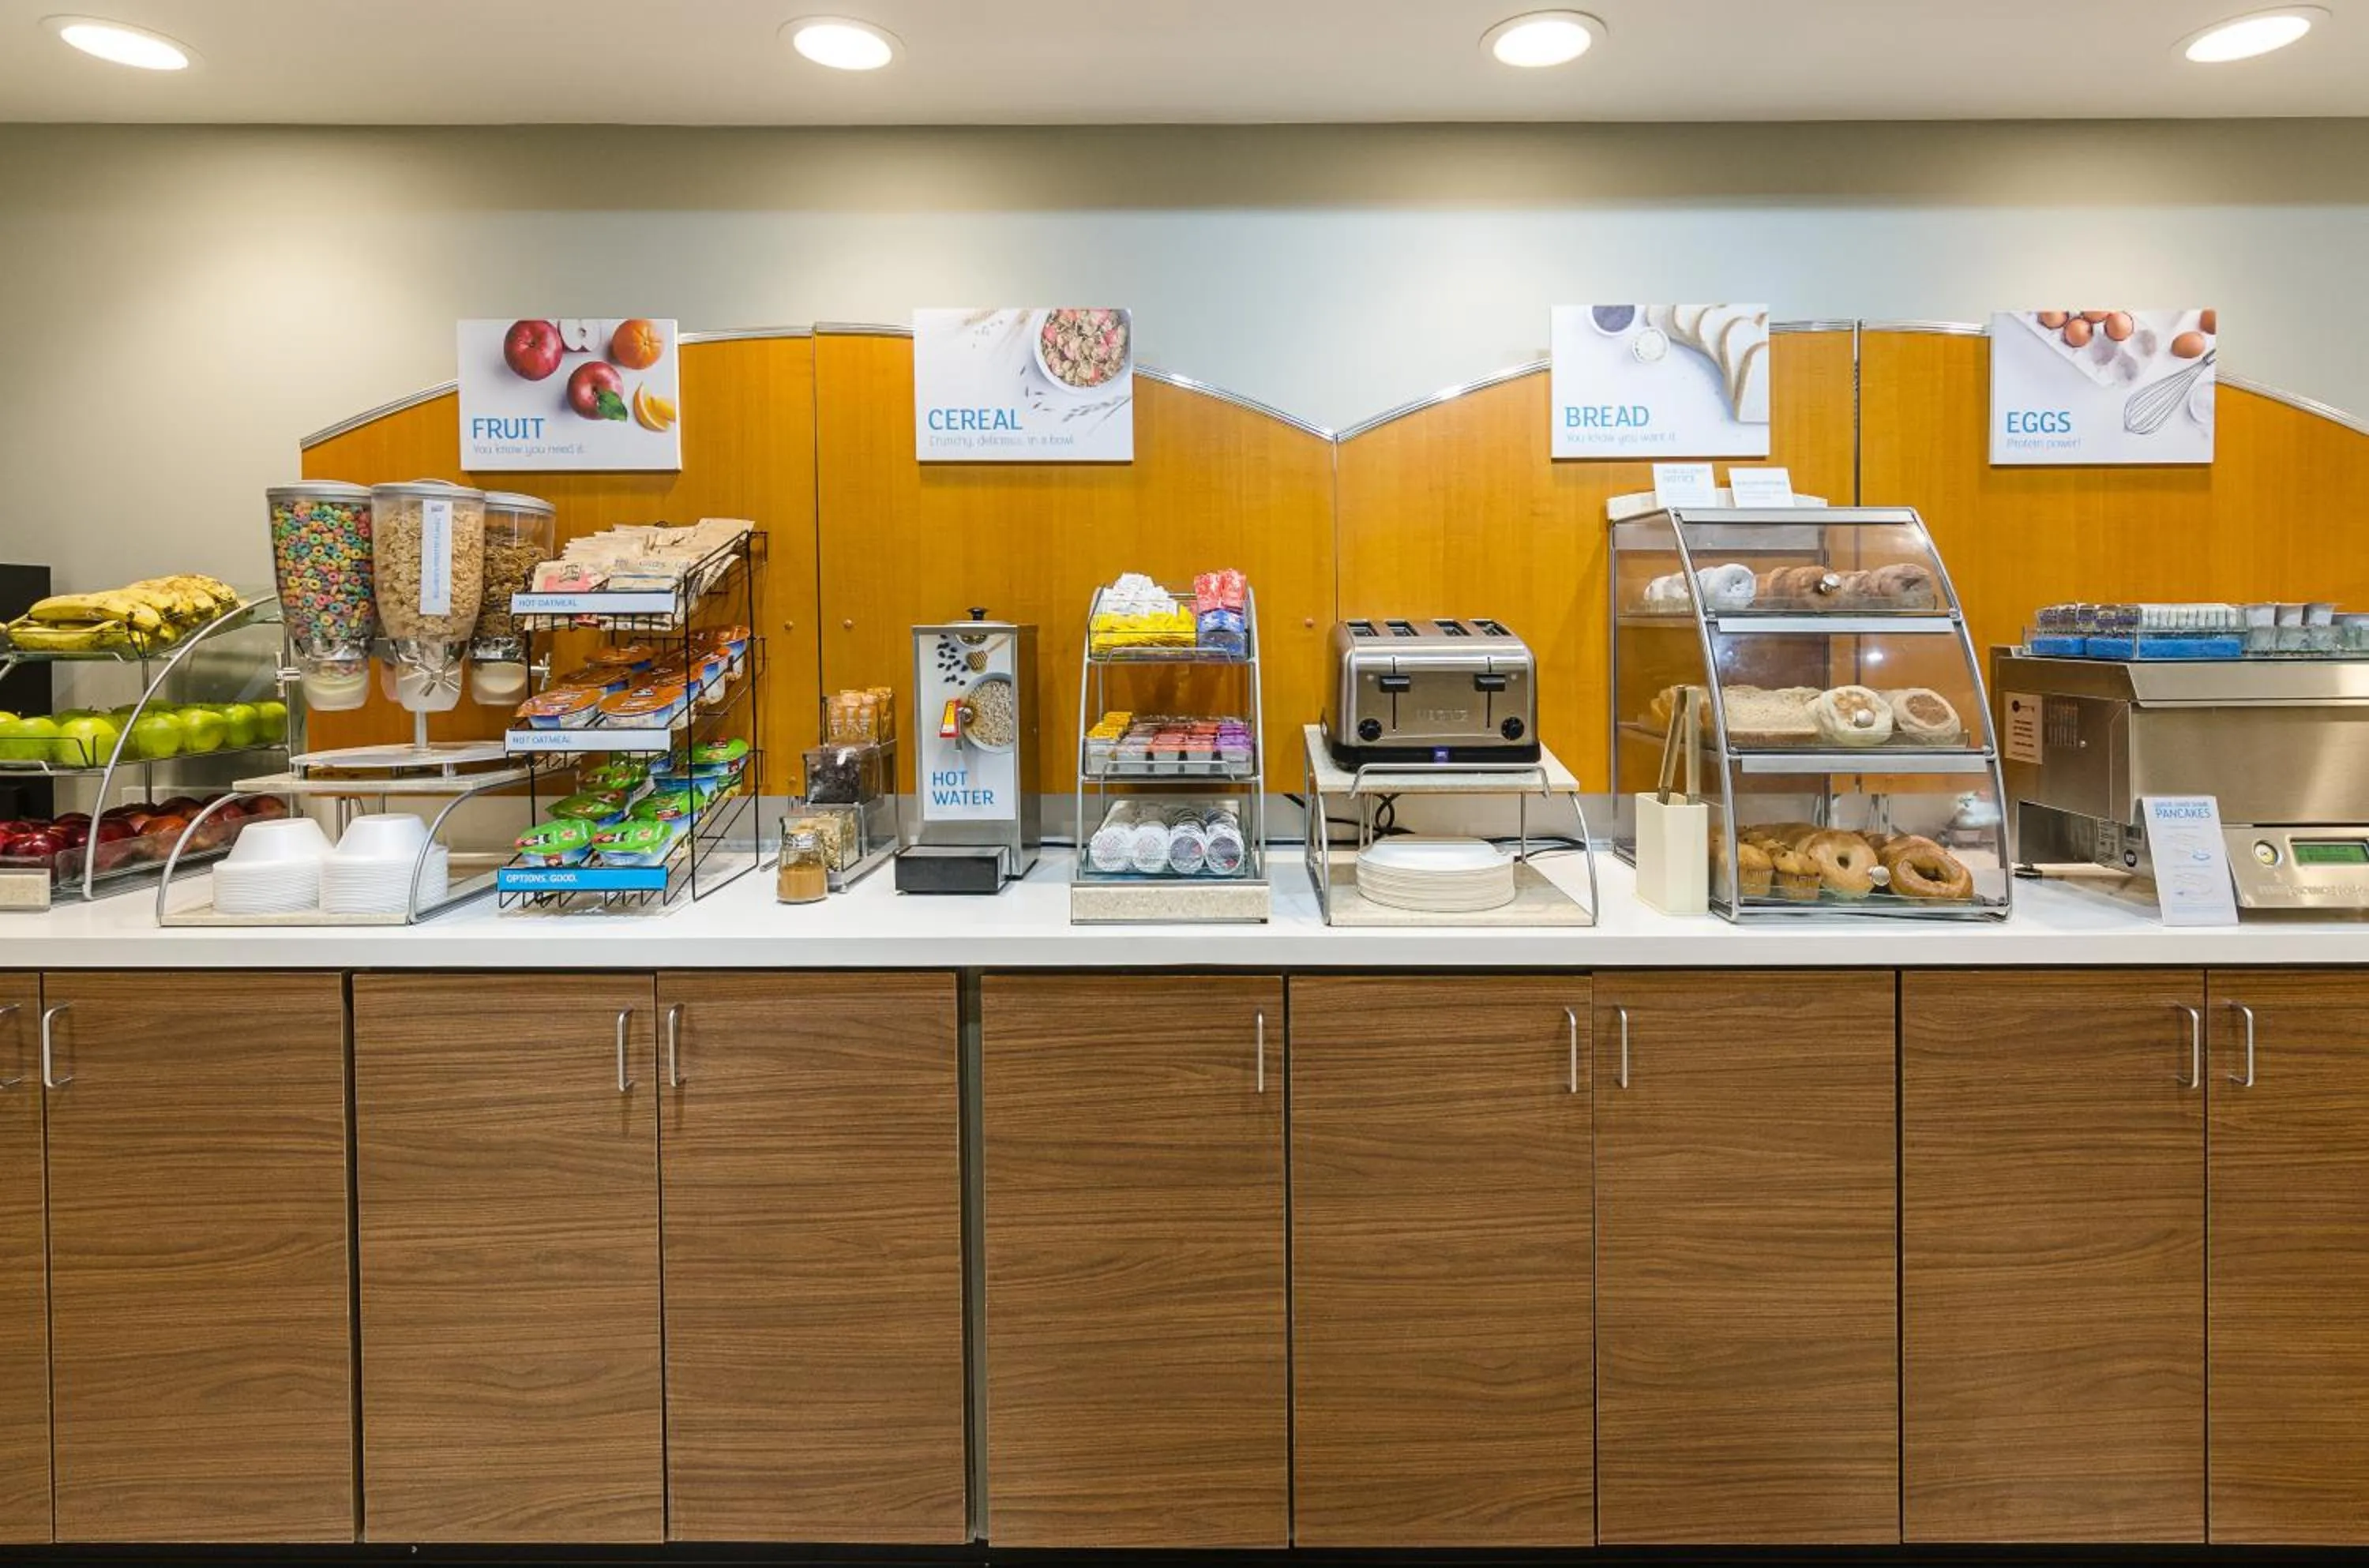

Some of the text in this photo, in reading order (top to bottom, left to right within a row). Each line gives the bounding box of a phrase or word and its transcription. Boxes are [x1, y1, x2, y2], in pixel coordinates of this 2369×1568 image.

[928, 408, 1023, 430] CEREAL
[1565, 406, 1650, 427] BREAD
[2007, 411, 2071, 433] EGGS
[472, 418, 545, 439] FRUIT
[1567, 433, 1584, 443] You
[2007, 438, 2043, 449] Protein
[474, 444, 492, 454] You
[495, 443, 523, 454] know
[525, 445, 546, 456] you
[548, 443, 574, 454] need
[518, 598, 576, 607] HOT OATMEAL
[512, 735, 571, 745] HOT OATMEAL
[933, 770, 968, 786] HOT
[932, 790, 994, 805] WATER
[2155, 808, 2211, 819] PANCAKES
